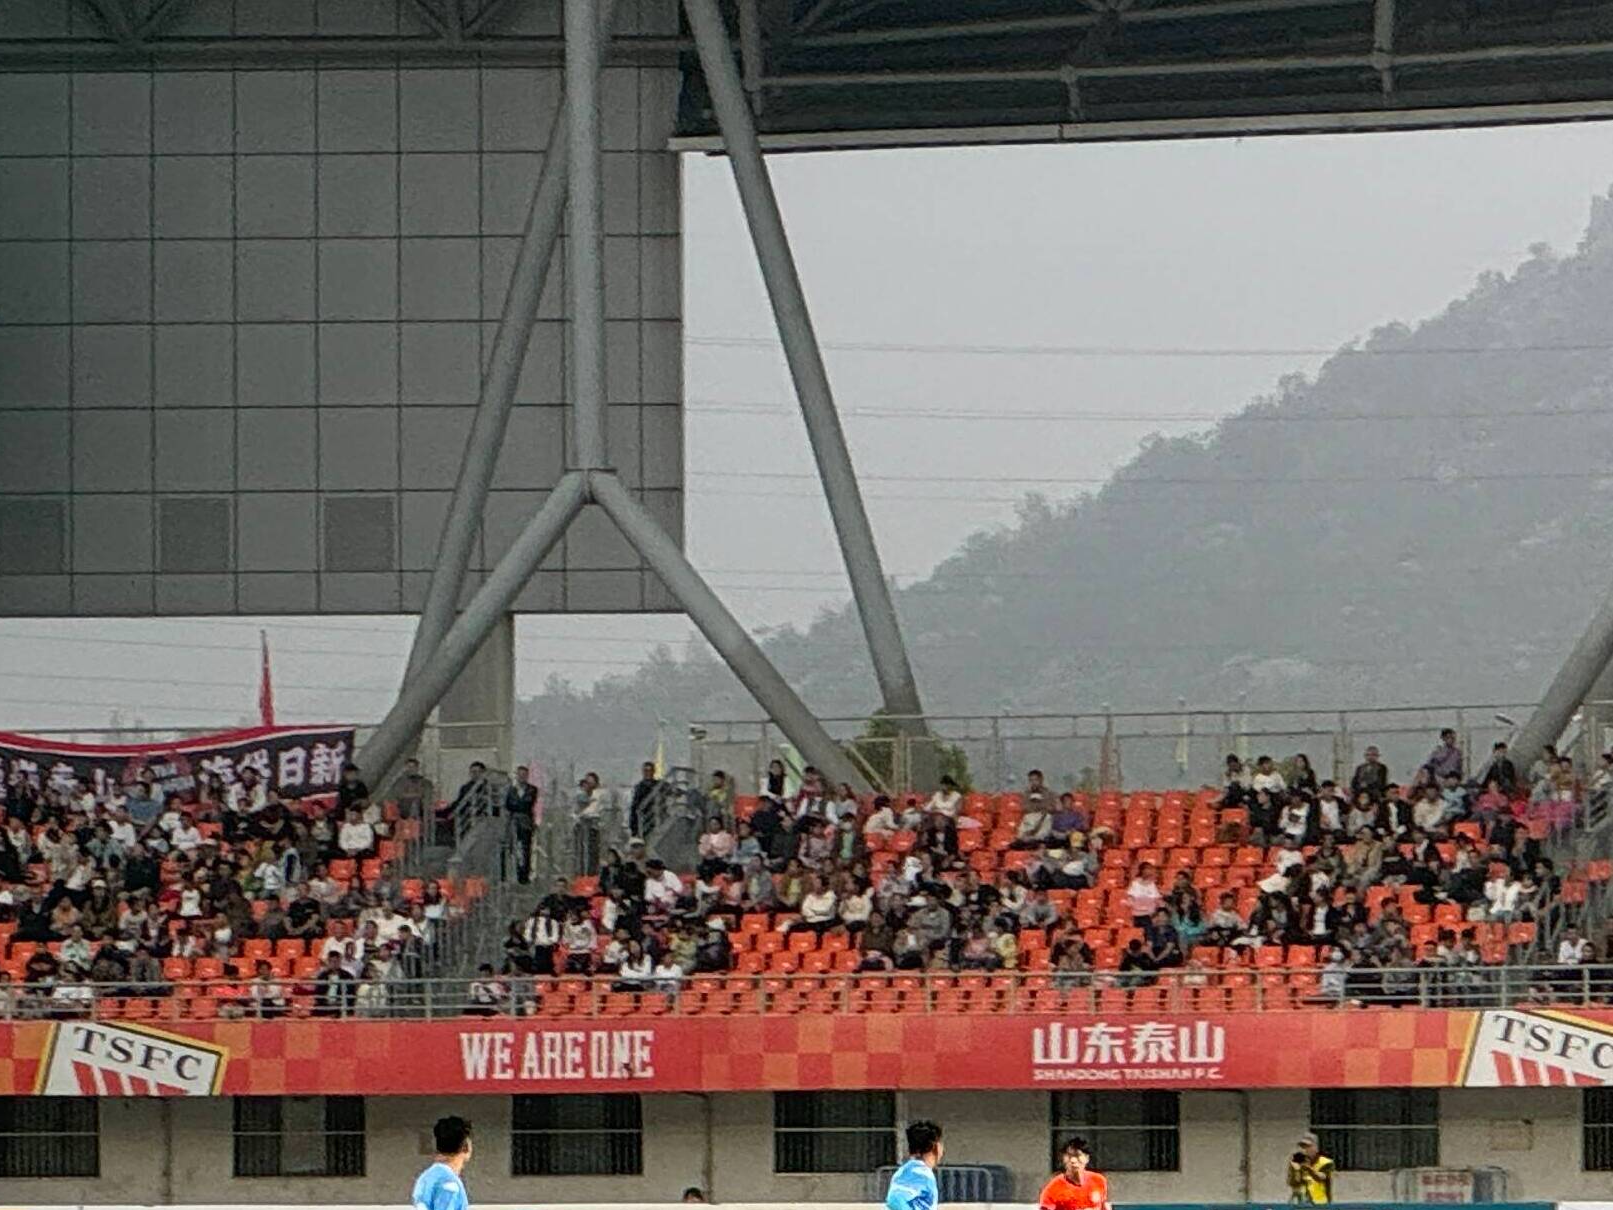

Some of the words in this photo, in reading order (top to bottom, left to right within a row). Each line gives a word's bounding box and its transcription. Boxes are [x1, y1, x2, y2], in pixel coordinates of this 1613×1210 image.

[73, 1026, 202, 1081] TSFC
[459, 1032, 515, 1080] WE
[520, 1031, 586, 1079] ARE
[591, 1030, 655, 1079] ONE
[1033, 1020, 1225, 1064] 山东泰山
[1492, 1014, 1613, 1070] TSFC
[1033, 1068, 1122, 1081] SHANDONG
[1124, 1067, 1192, 1080] TAISHAN
